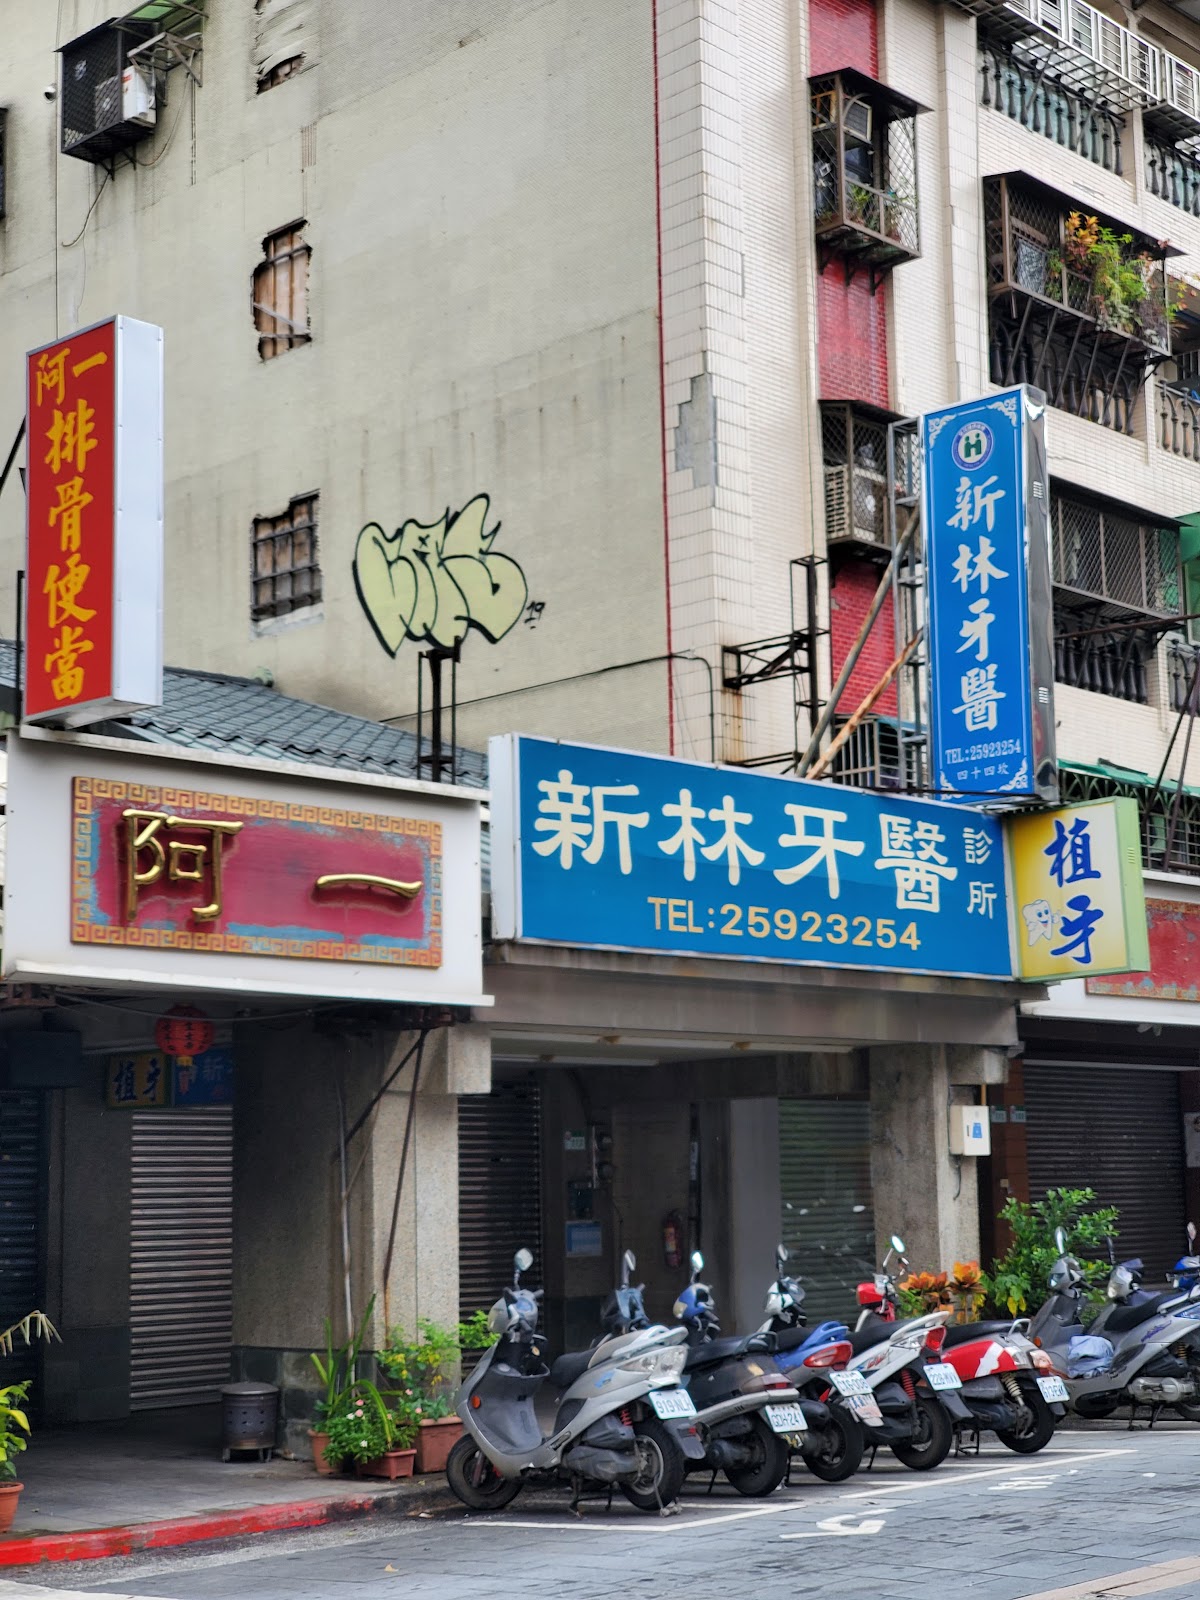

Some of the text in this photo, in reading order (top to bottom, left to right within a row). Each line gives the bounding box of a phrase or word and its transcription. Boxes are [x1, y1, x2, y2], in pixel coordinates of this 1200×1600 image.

[43, 399, 99, 701] 排骨便當
[946, 475, 1009, 733] 新林牙醫
[945, 738, 1021, 765] TEL:25923254
[122, 808, 424, 922] 阿一
[531, 768, 958, 914] 新林牙醫
[963, 826, 997, 920] 診所
[1043, 818, 1101, 964] 植牙
[646, 896, 922, 952] TEL:25923254
